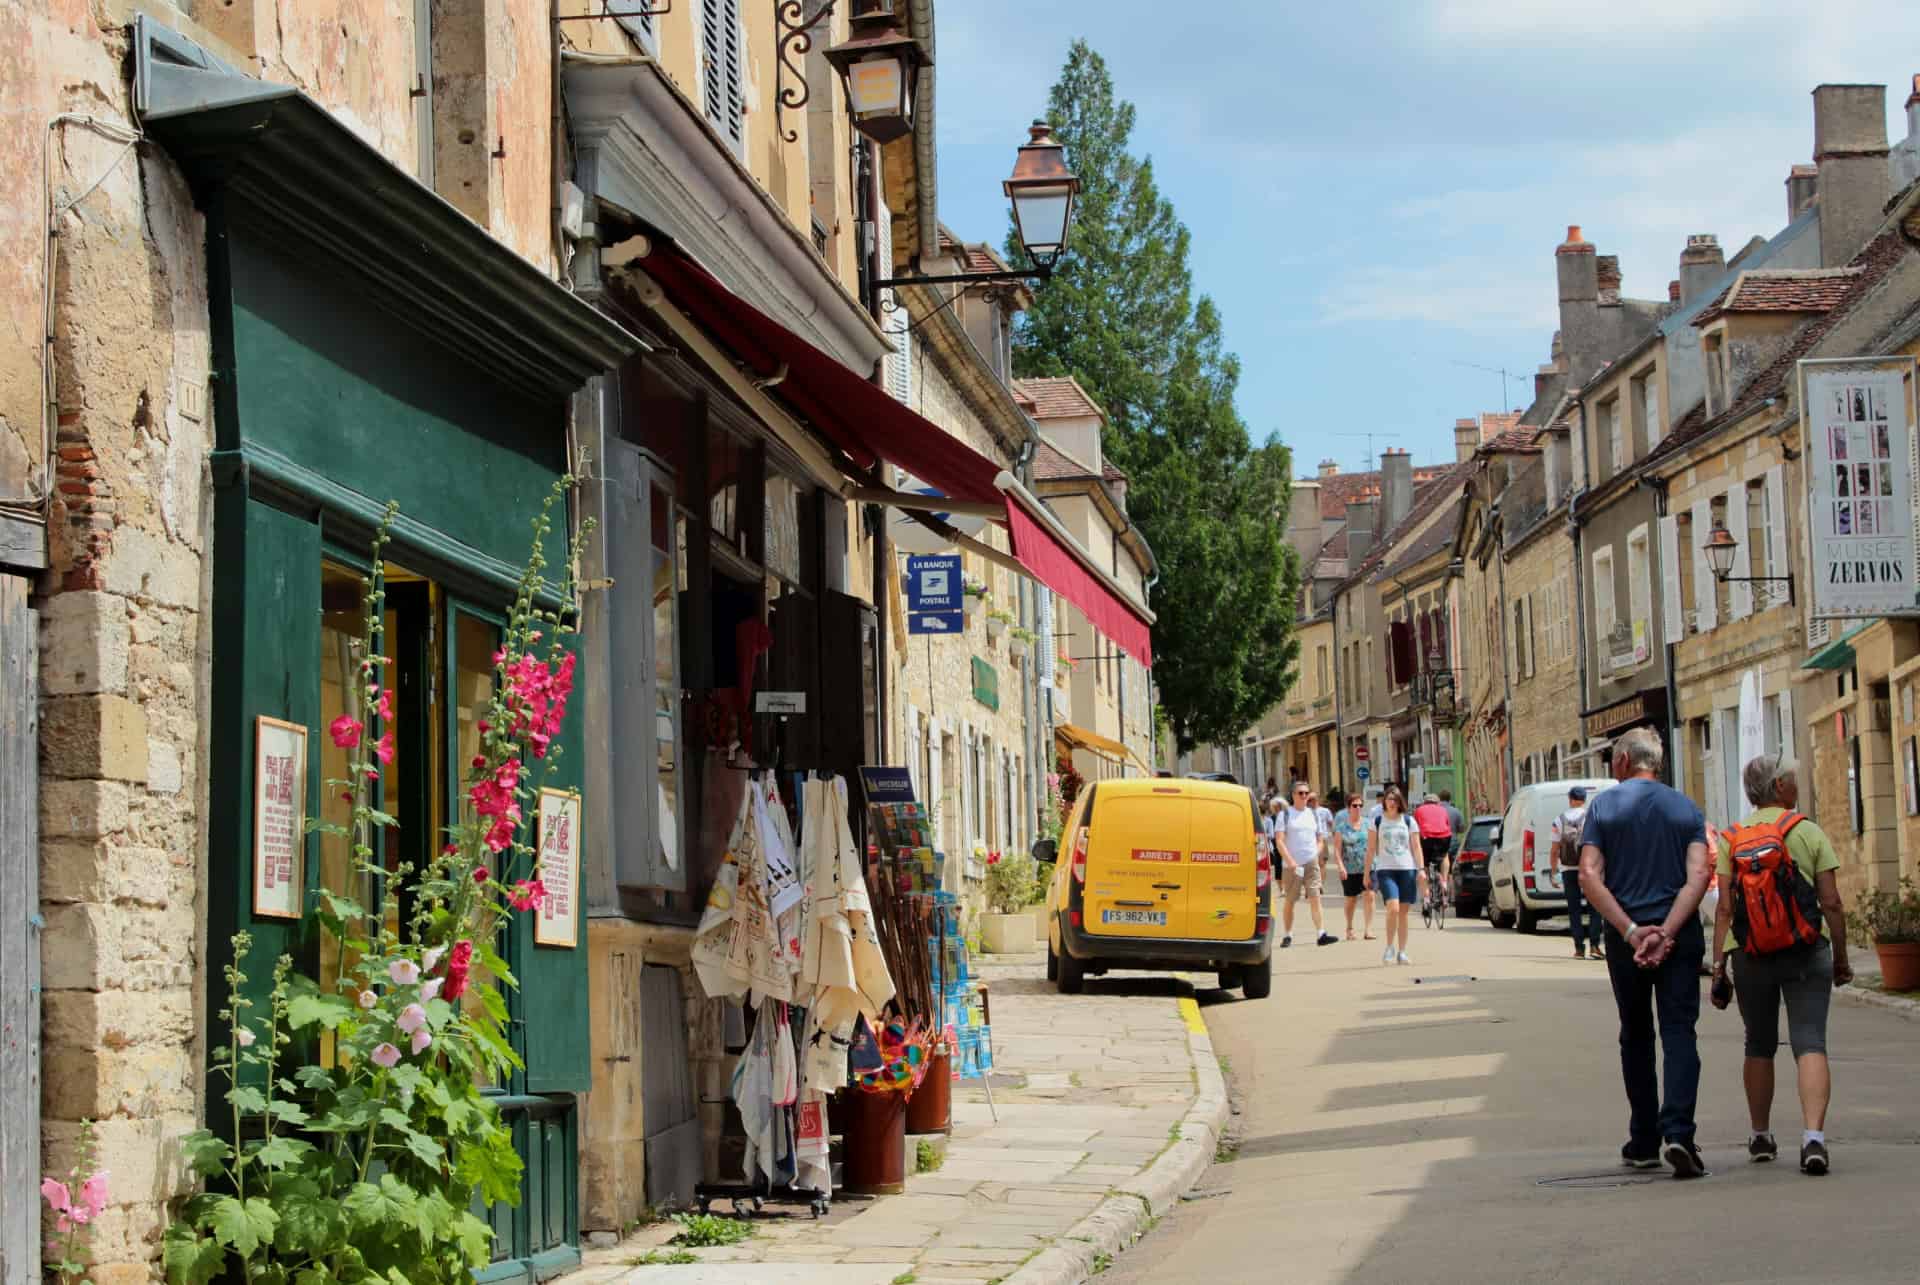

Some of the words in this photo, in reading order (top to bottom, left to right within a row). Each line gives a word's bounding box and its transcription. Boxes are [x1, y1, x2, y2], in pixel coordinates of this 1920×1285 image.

[1827, 541, 1904, 559] MUSÉE
[913, 561, 923, 569] LA
[924, 560, 955, 569] BANQUE
[1829, 560, 1903, 584] ZERVOS
[920, 596, 950, 605] POSTALE
